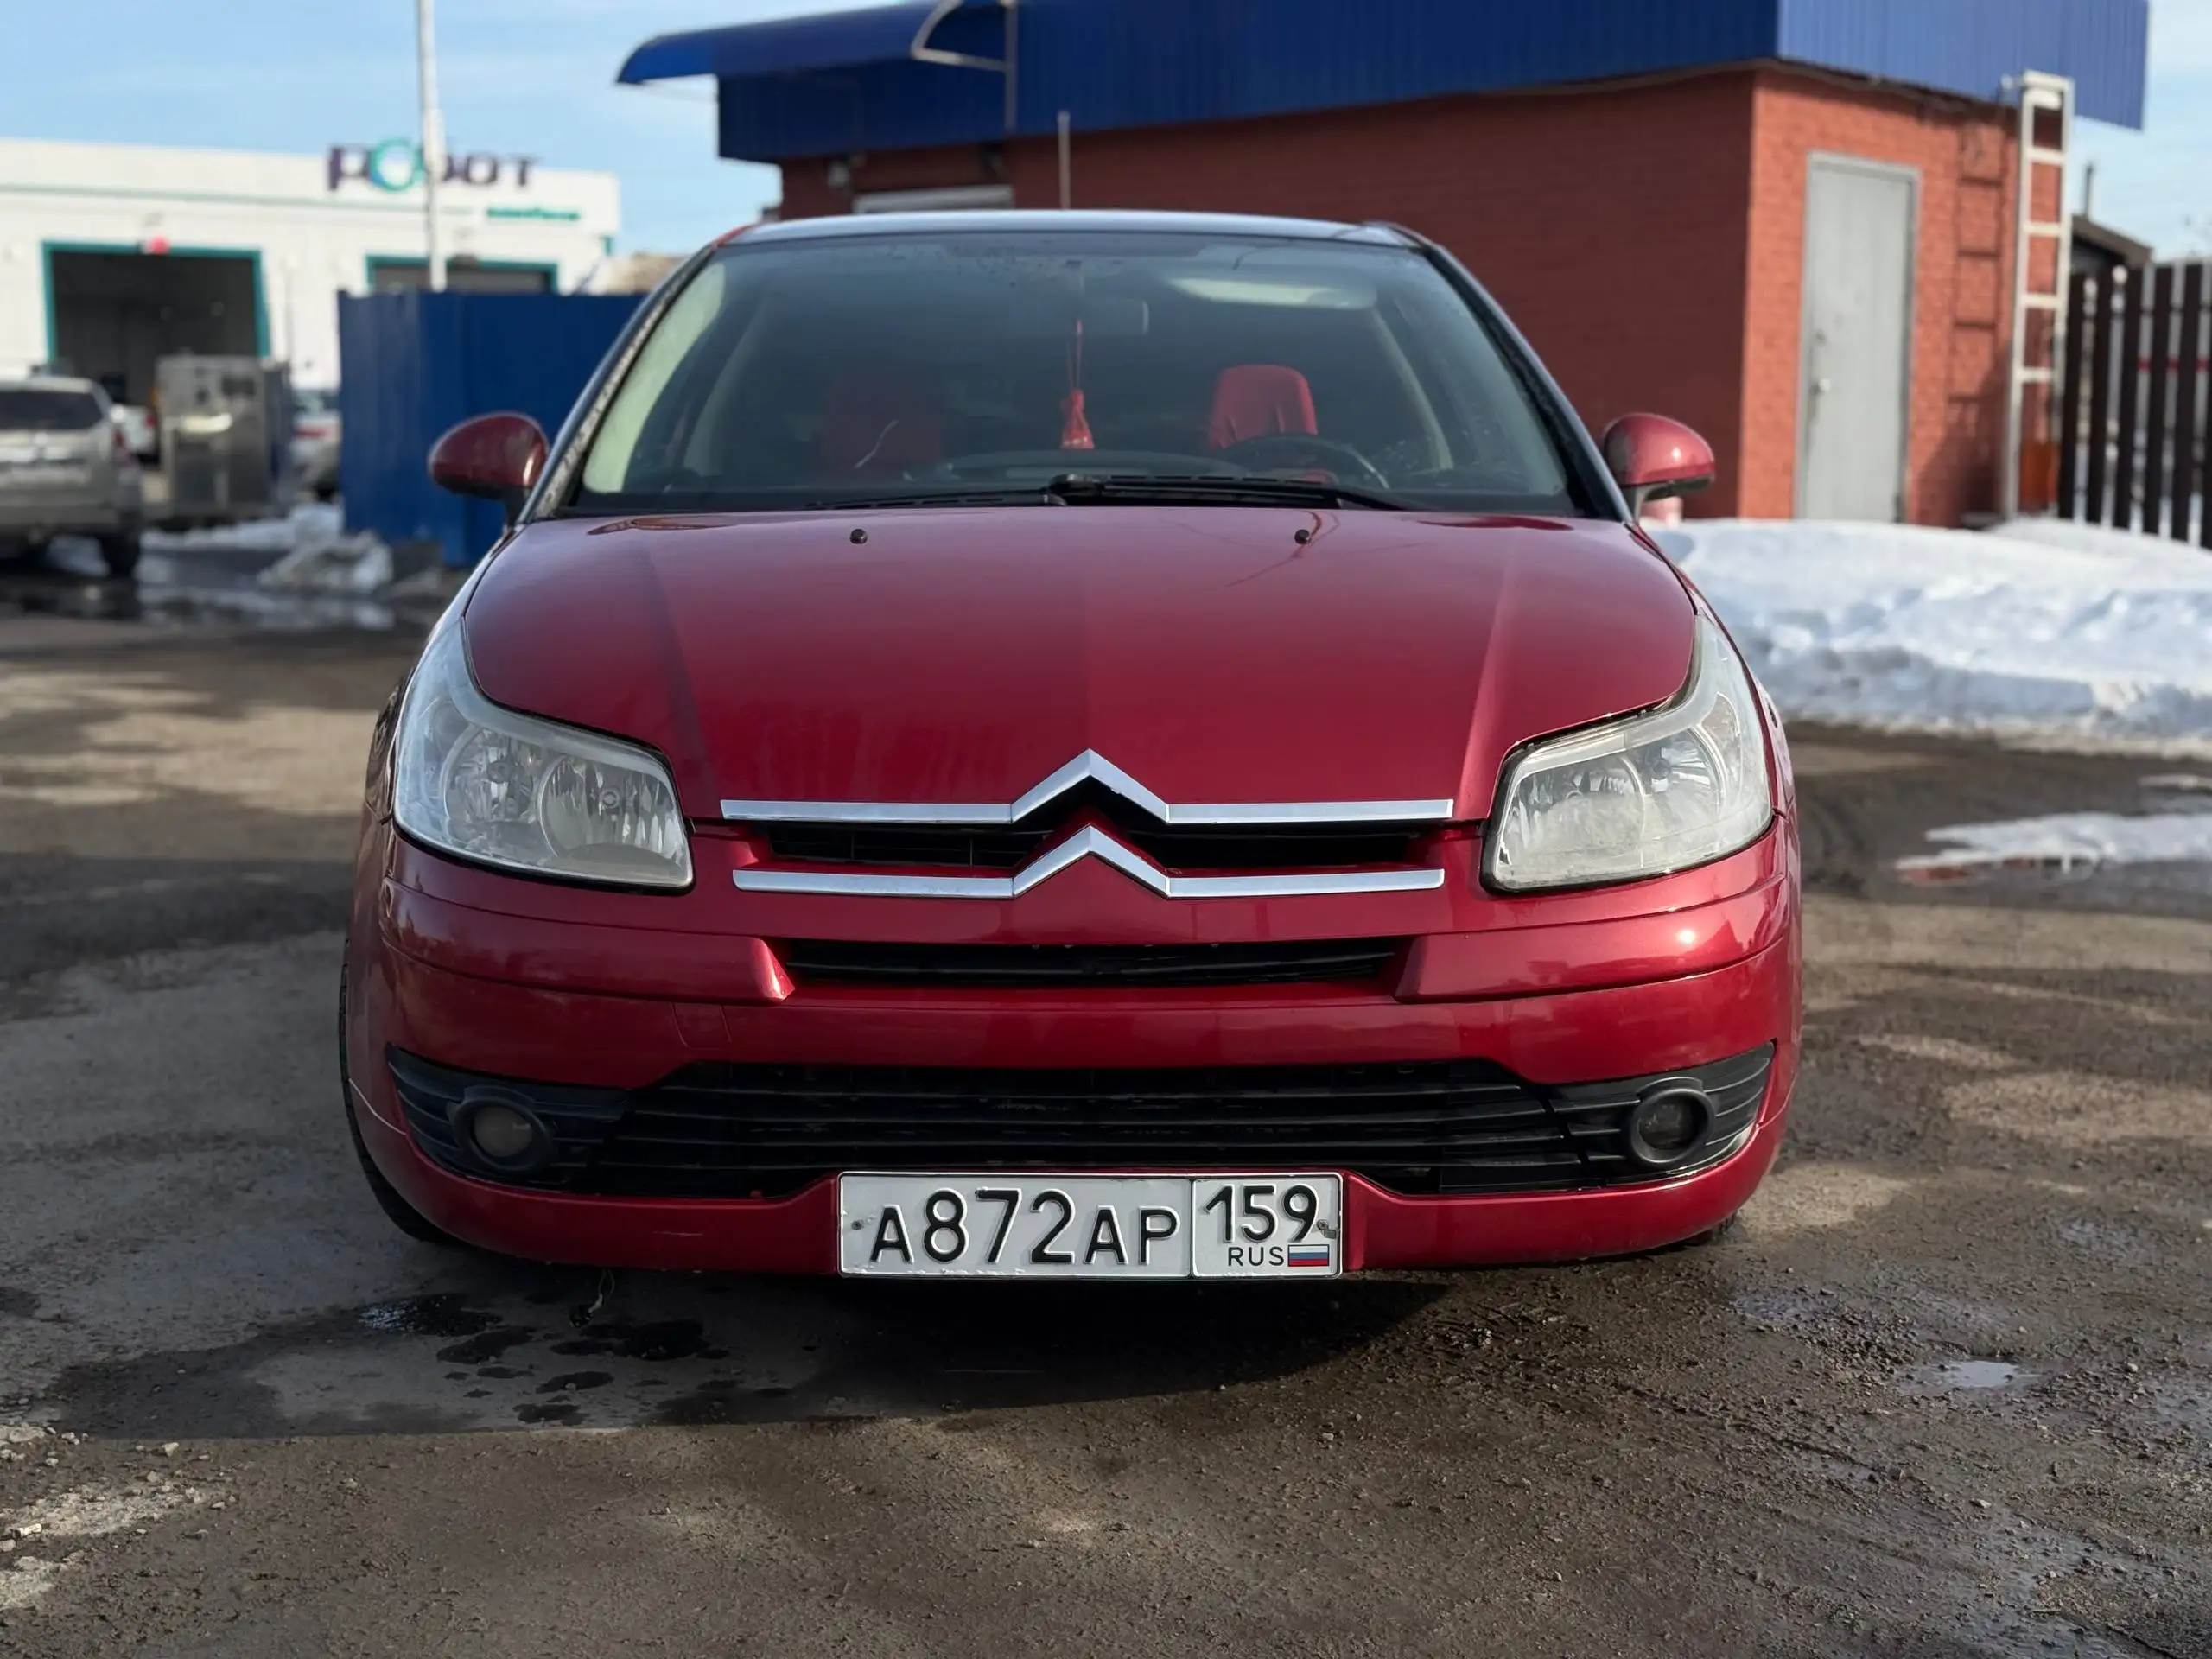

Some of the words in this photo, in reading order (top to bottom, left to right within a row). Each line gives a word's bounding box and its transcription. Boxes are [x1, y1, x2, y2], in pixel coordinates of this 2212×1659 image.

[868, 1188, 1179, 1264] А872АР
[1205, 1184, 1319, 1243] 159
[1227, 1245, 1286, 1267] RUS
